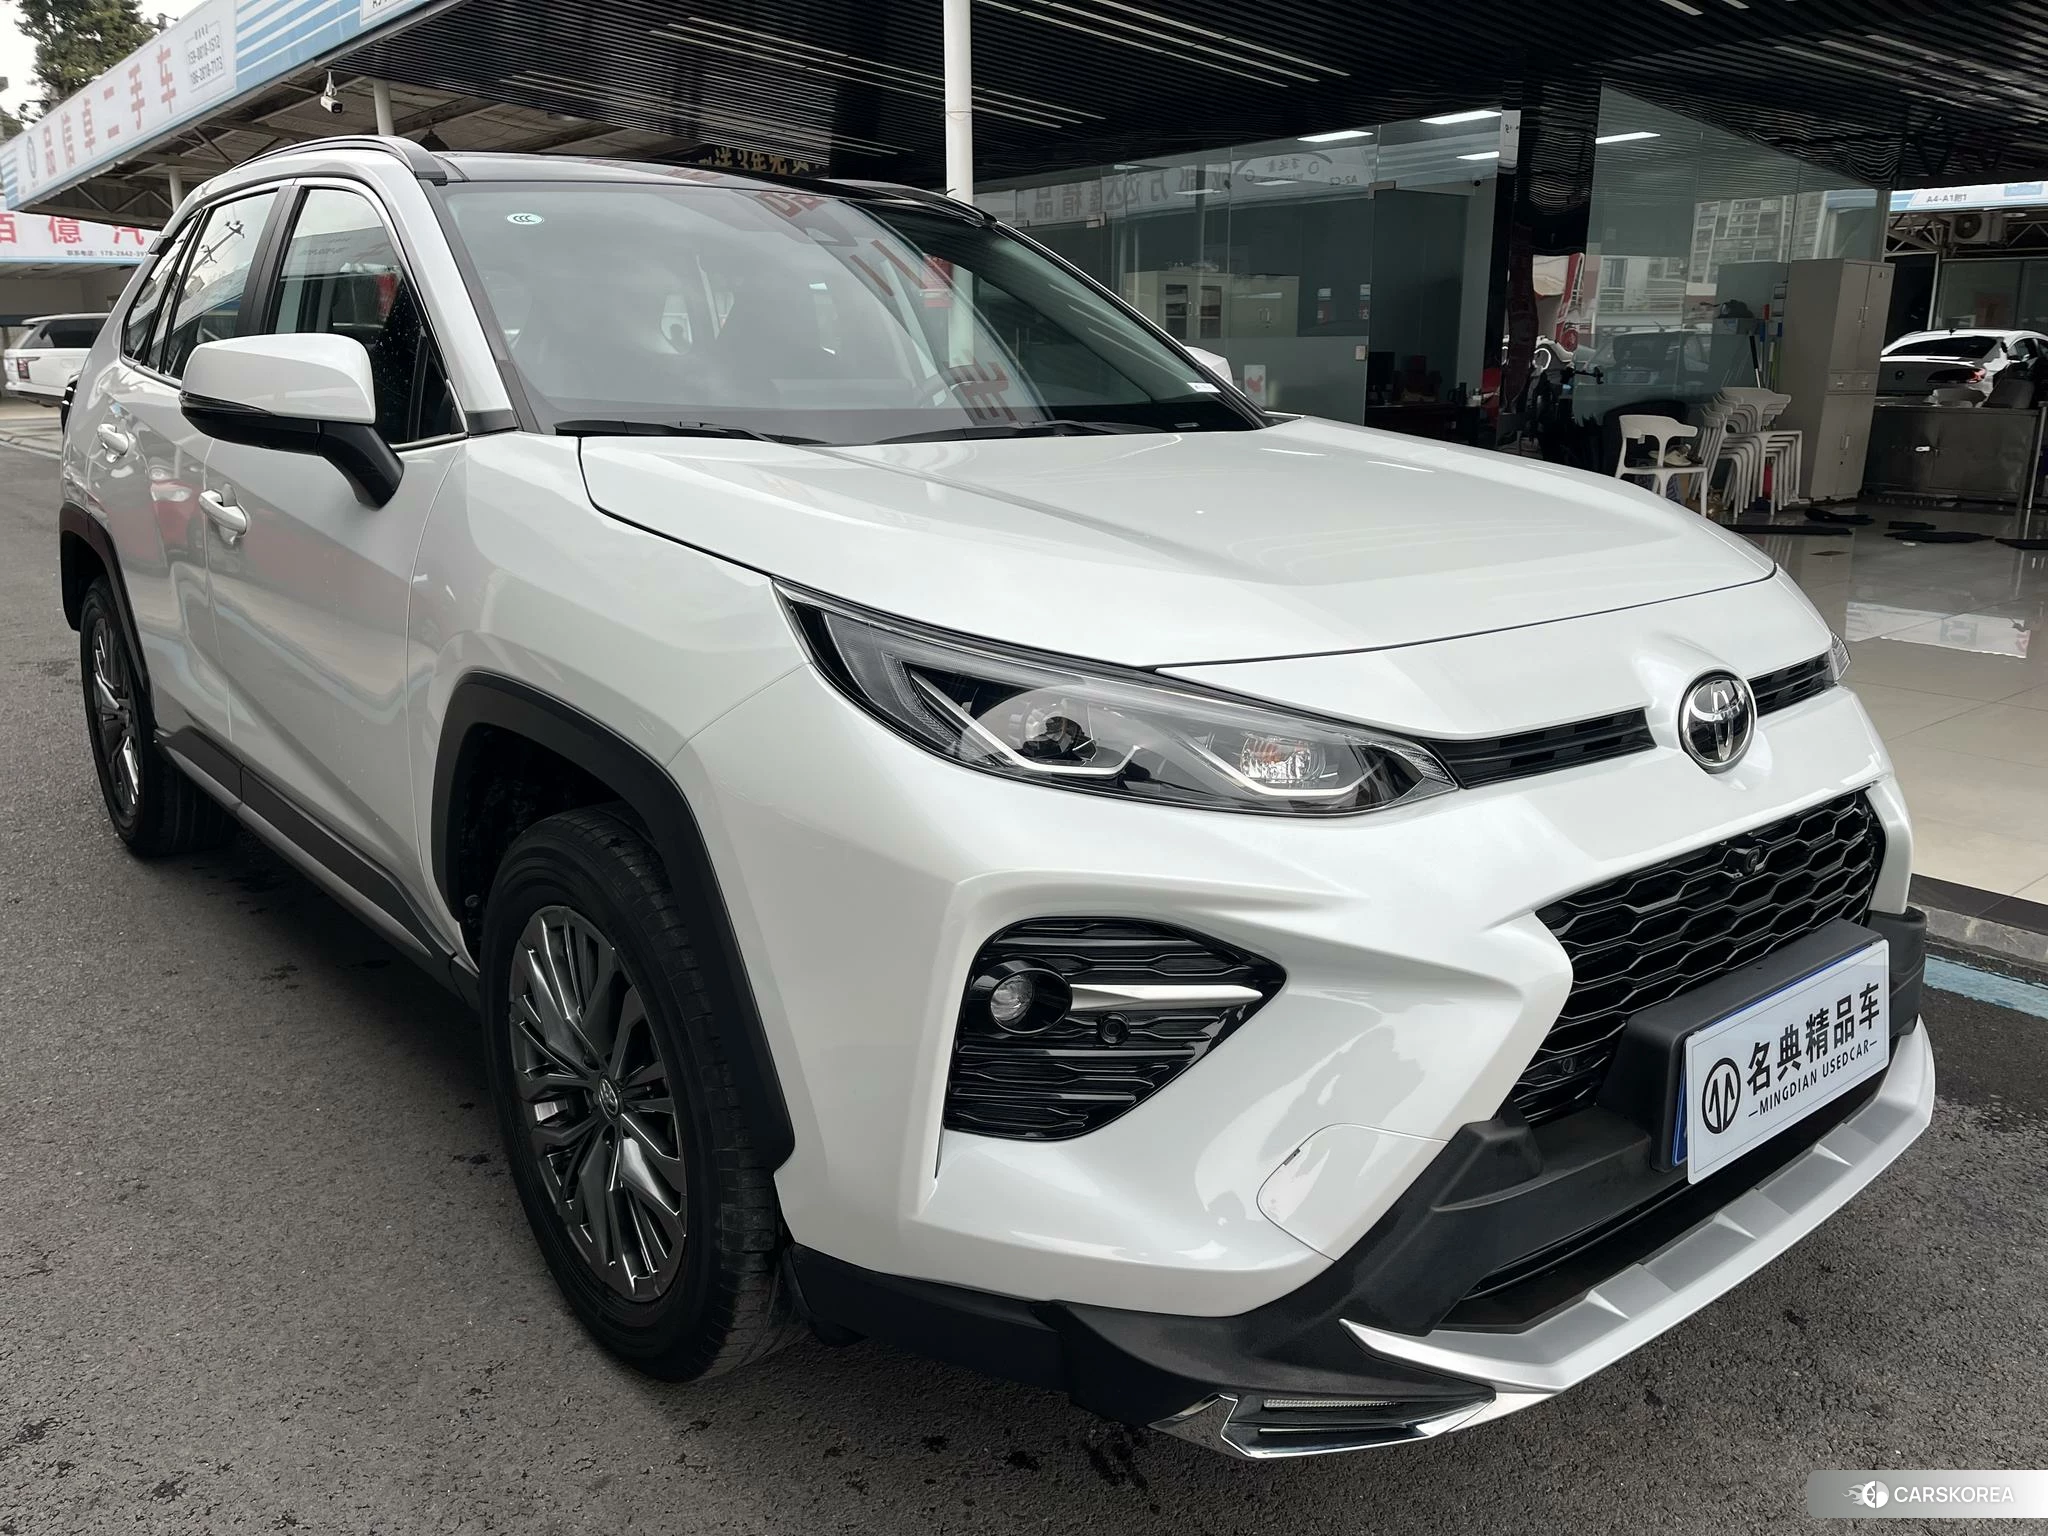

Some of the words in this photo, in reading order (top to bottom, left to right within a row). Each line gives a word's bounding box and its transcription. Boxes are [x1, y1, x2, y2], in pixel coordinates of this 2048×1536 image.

[1746, 982, 1880, 1096] 名典精品车
